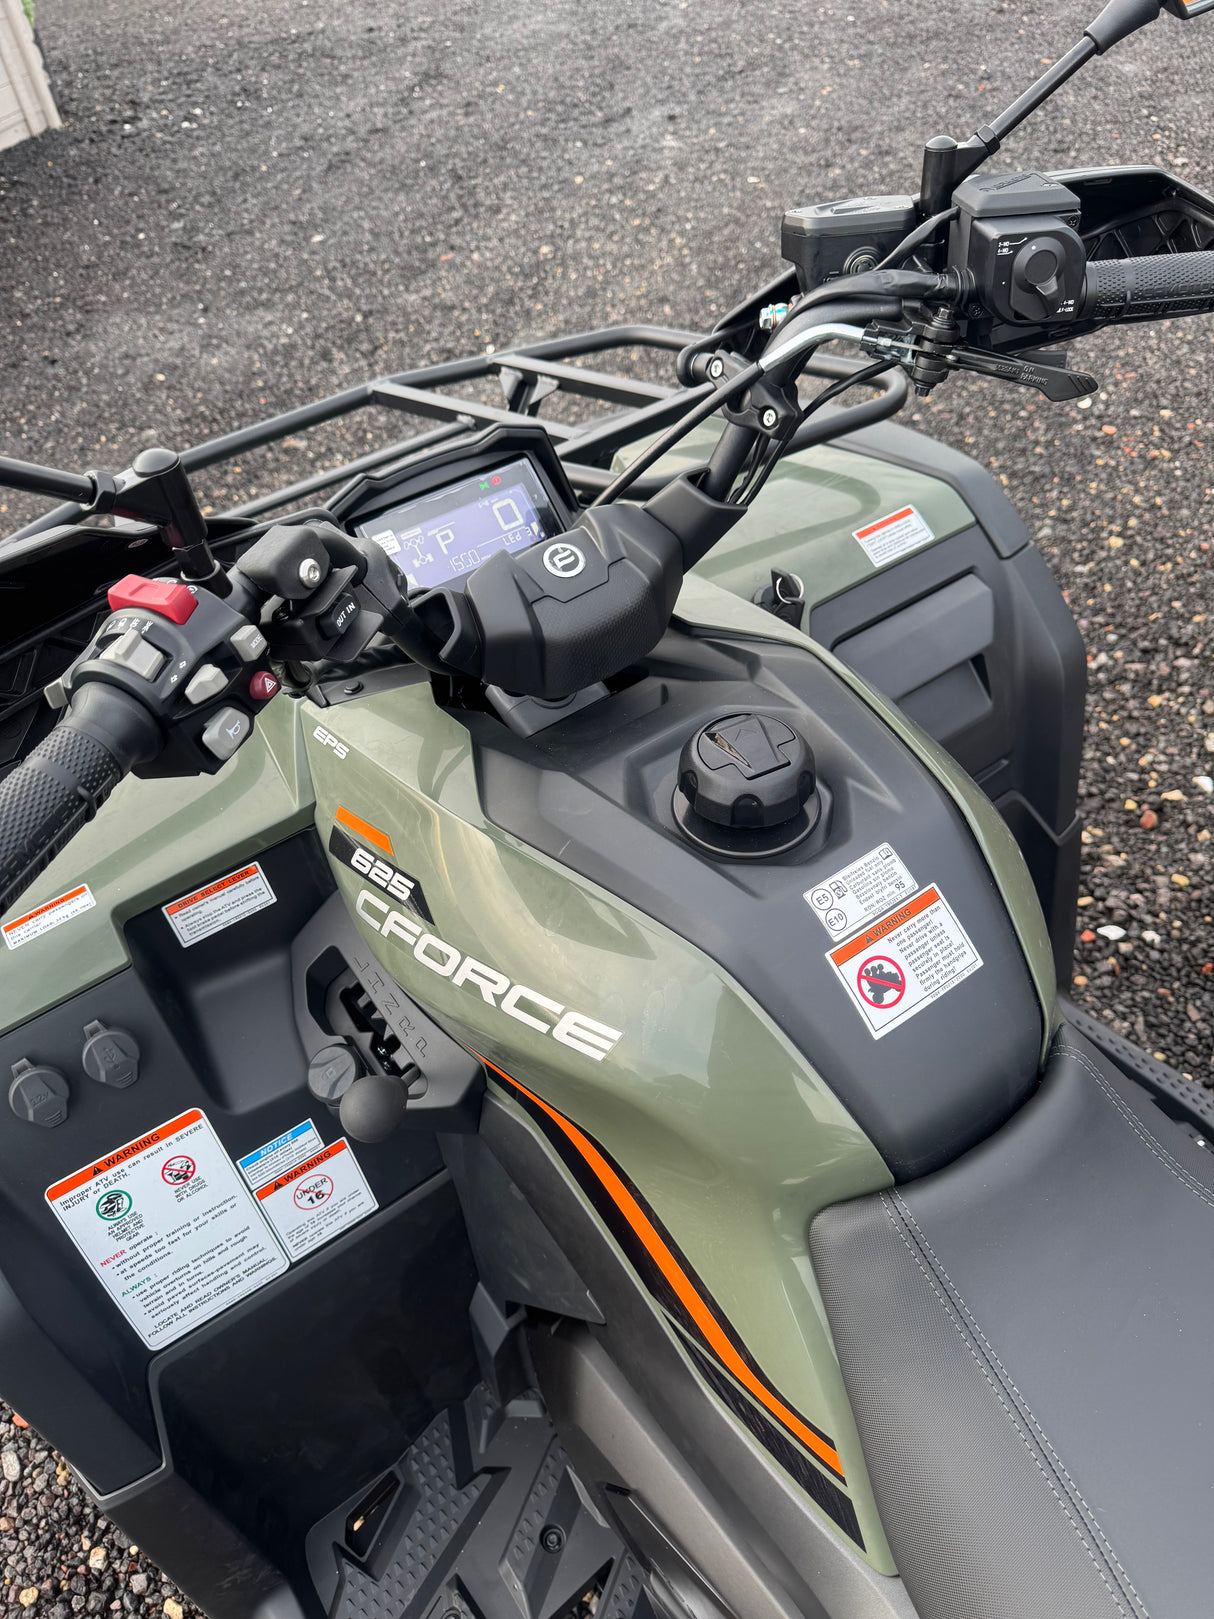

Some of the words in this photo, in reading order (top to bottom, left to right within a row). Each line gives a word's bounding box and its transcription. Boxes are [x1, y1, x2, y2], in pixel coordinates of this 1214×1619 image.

[436, 529, 455, 554] P
[337, 611, 346, 627] OUT
[346, 602, 355, 613] IN
[312, 726, 349, 760] EPS
[351, 848, 415, 900] 625
[894, 880, 905, 890] 95
[177, 896, 197, 908] DRIVE
[200, 881, 225, 896] SELECT
[227, 870, 249, 883] LEVER
[815, 893, 829, 905] E5
[34, 898, 64, 915] WARNING
[827, 912, 843, 926] E10
[872, 908, 911, 936] WARNING
[886, 931, 902, 943] Never
[903, 922, 916, 933] carry
[916, 913, 929, 923] more
[929, 905, 940, 914] than
[896, 938, 906, 946] one
[898, 941, 914, 953] Never
[914, 932, 927, 943] drive
[927, 924, 938, 934] with
[904, 940, 929, 960] passenger
[929, 929, 945, 942] unless
[908, 946, 933, 967] passenger
[933, 938, 944, 948] seat
[912, 956, 933, 972] securely
[915, 959, 940, 979] Passenger
[941, 950, 954, 961] must
[953, 941, 964, 952] hold
[919, 973, 934, 985] firmly
[934, 967, 943, 975] the
[942, 950, 966, 968] handgrips
[356, 890, 623, 1061] CFORCE
[923, 978, 940, 992] during
[368, 972, 384, 994] H
[383, 993, 399, 1015] N
[399, 1016, 415, 1037] R
[416, 1037, 427, 1057] P
[103, 1133, 159, 1166] WARNING
[260, 1132, 292, 1156] NOTICE
[59, 1186, 91, 1206] Improper
[95, 1176, 108, 1187] ATV
[112, 1168, 124, 1177] use
[127, 1159, 140, 1168] can
[143, 1146, 163, 1160] result
[175, 1123, 203, 1142] SEVERE
[283, 1150, 330, 1182] WARNING
[62, 1193, 88, 1211] INJURY
[102, 1172, 130, 1188] DEATH.
[173, 1182, 190, 1193] NEVER
[191, 1175, 201, 1183] USE
[174, 1189, 187, 1198] WITH
[188, 1179, 205, 1191] DRUGS
[186, 1183, 208, 1198] ALCOHOL
[296, 1177, 327, 1199] UNDER
[307, 1190, 324, 1204] 16
[107, 1217, 127, 1230] ALWAYS
[112, 1225, 130, 1238] HELMET
[132, 1218, 143, 1226] AND
[115, 1251, 140, 1267] without
[142, 1237, 163, 1252] proper
[165, 1221, 191, 1238] training
[201, 1195, 237, 1216] instruction.
[115, 1223, 144, 1242] PROTECTIVE
[116, 1213, 142, 1230] APPROVED
[125, 1231, 139, 1241] GEAR
[129, 1253, 152, 1268] speeds
[154, 1245, 165, 1253] too
[167, 1236, 180, 1245] fast
[194, 1220, 208, 1230] your
[211, 1209, 227, 1219] skills
[100, 1249, 126, 1267] NEVER
[128, 1234, 152, 1250] operate
[135, 1288, 147, 1296] use
[149, 1274, 169, 1289] proper
[171, 1263, 190, 1275] riding
[191, 1242, 223, 1263] techniques
[234, 1225, 249, 1237] avoid
[137, 1251, 171, 1272] conditions.
[139, 1288, 160, 1302] vehicle
[162, 1270, 191, 1288] overturns
[202, 1255, 215, 1264] hills
[217, 1246, 228, 1255] and
[230, 1235, 247, 1247] rough
[147, 1300, 164, 1313] avoid
[167, 1287, 186, 1302] paved
[246, 1243, 258, 1252] may
[121, 1276, 151, 1296] ALWAYS
[143, 1294, 163, 1308] terrain
[165, 1286, 176, 1295] and
[151, 1300, 179, 1318] seriously
[182, 1287, 199, 1299] affect
[201, 1270, 228, 1288] handling
[230, 1261, 241, 1270] and
[147, 1320, 173, 1338] FOLLOW
[188, 1285, 230, 1313] INSTRUCTIONS
[232, 1276, 244, 1286] AND
[153, 1312, 178, 1328] LOCATE
[180, 1302, 193, 1312] AND
[194, 1291, 211, 1303] READ
